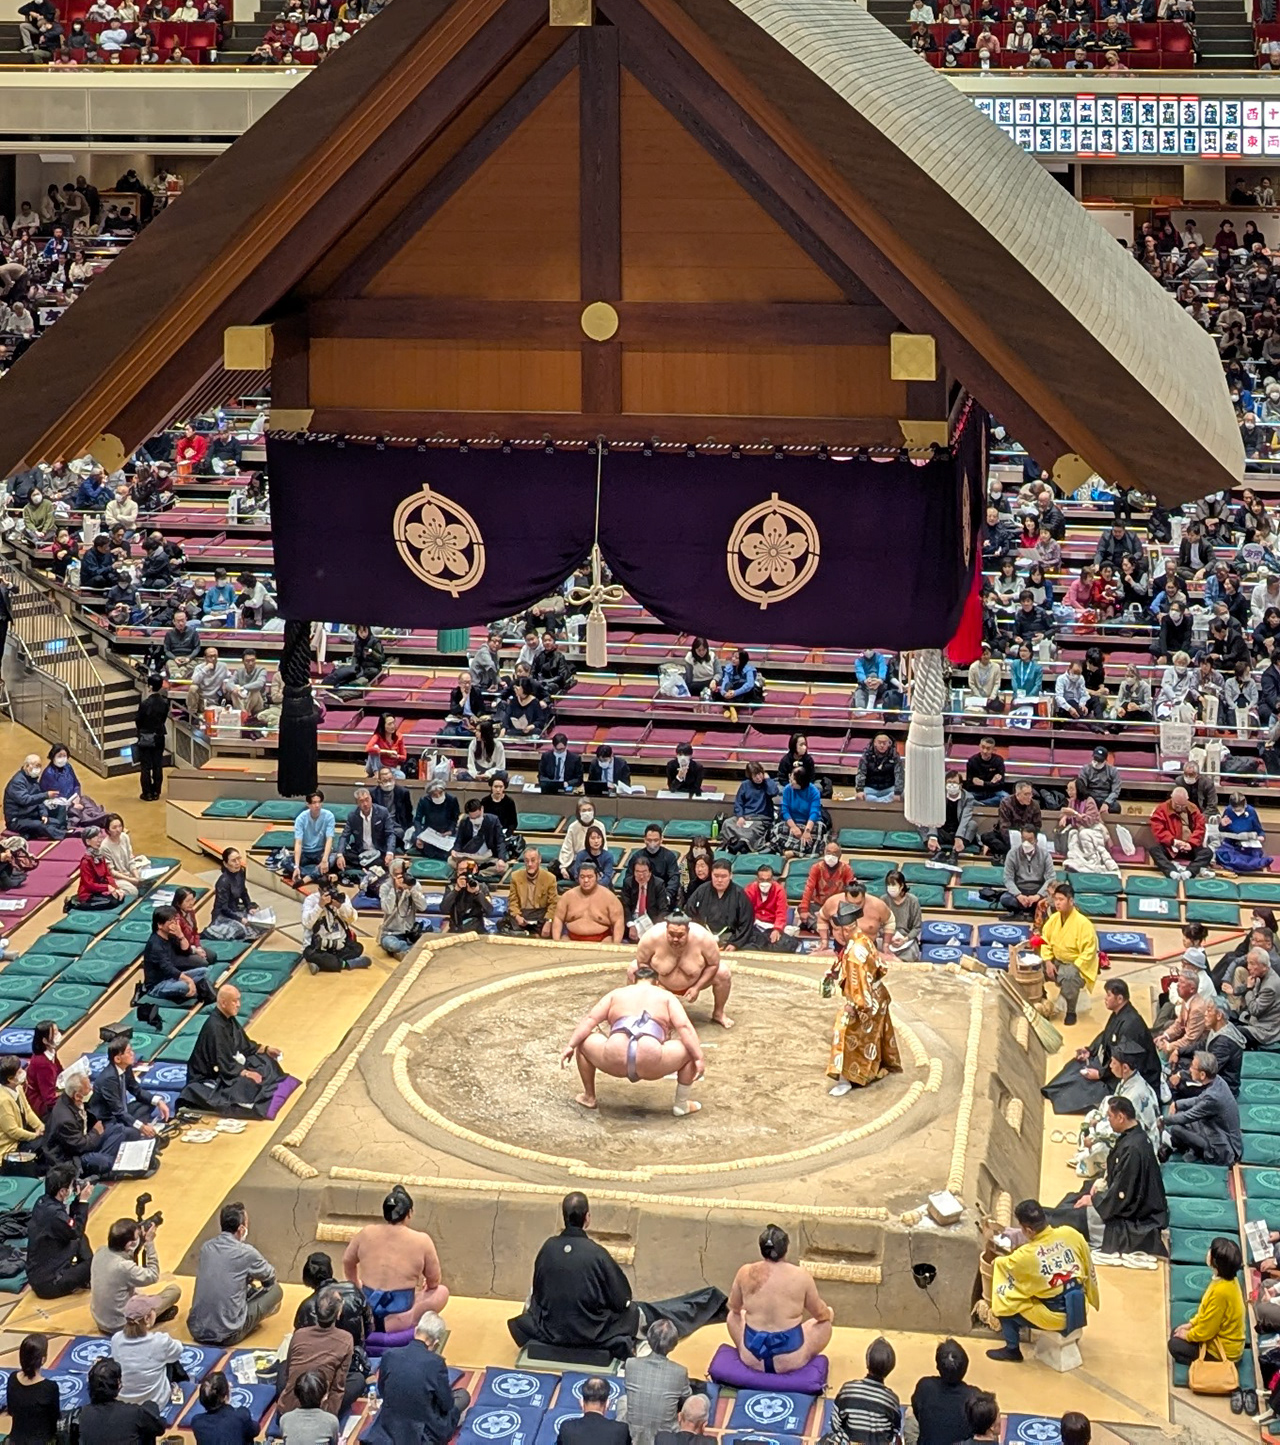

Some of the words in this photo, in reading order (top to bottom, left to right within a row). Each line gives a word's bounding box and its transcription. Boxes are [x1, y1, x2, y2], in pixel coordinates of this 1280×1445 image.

[1246, 107, 1259, 120] 西
[1247, 135, 1258, 147] 東
[1040, 1248, 1075, 1276] 永谷園
